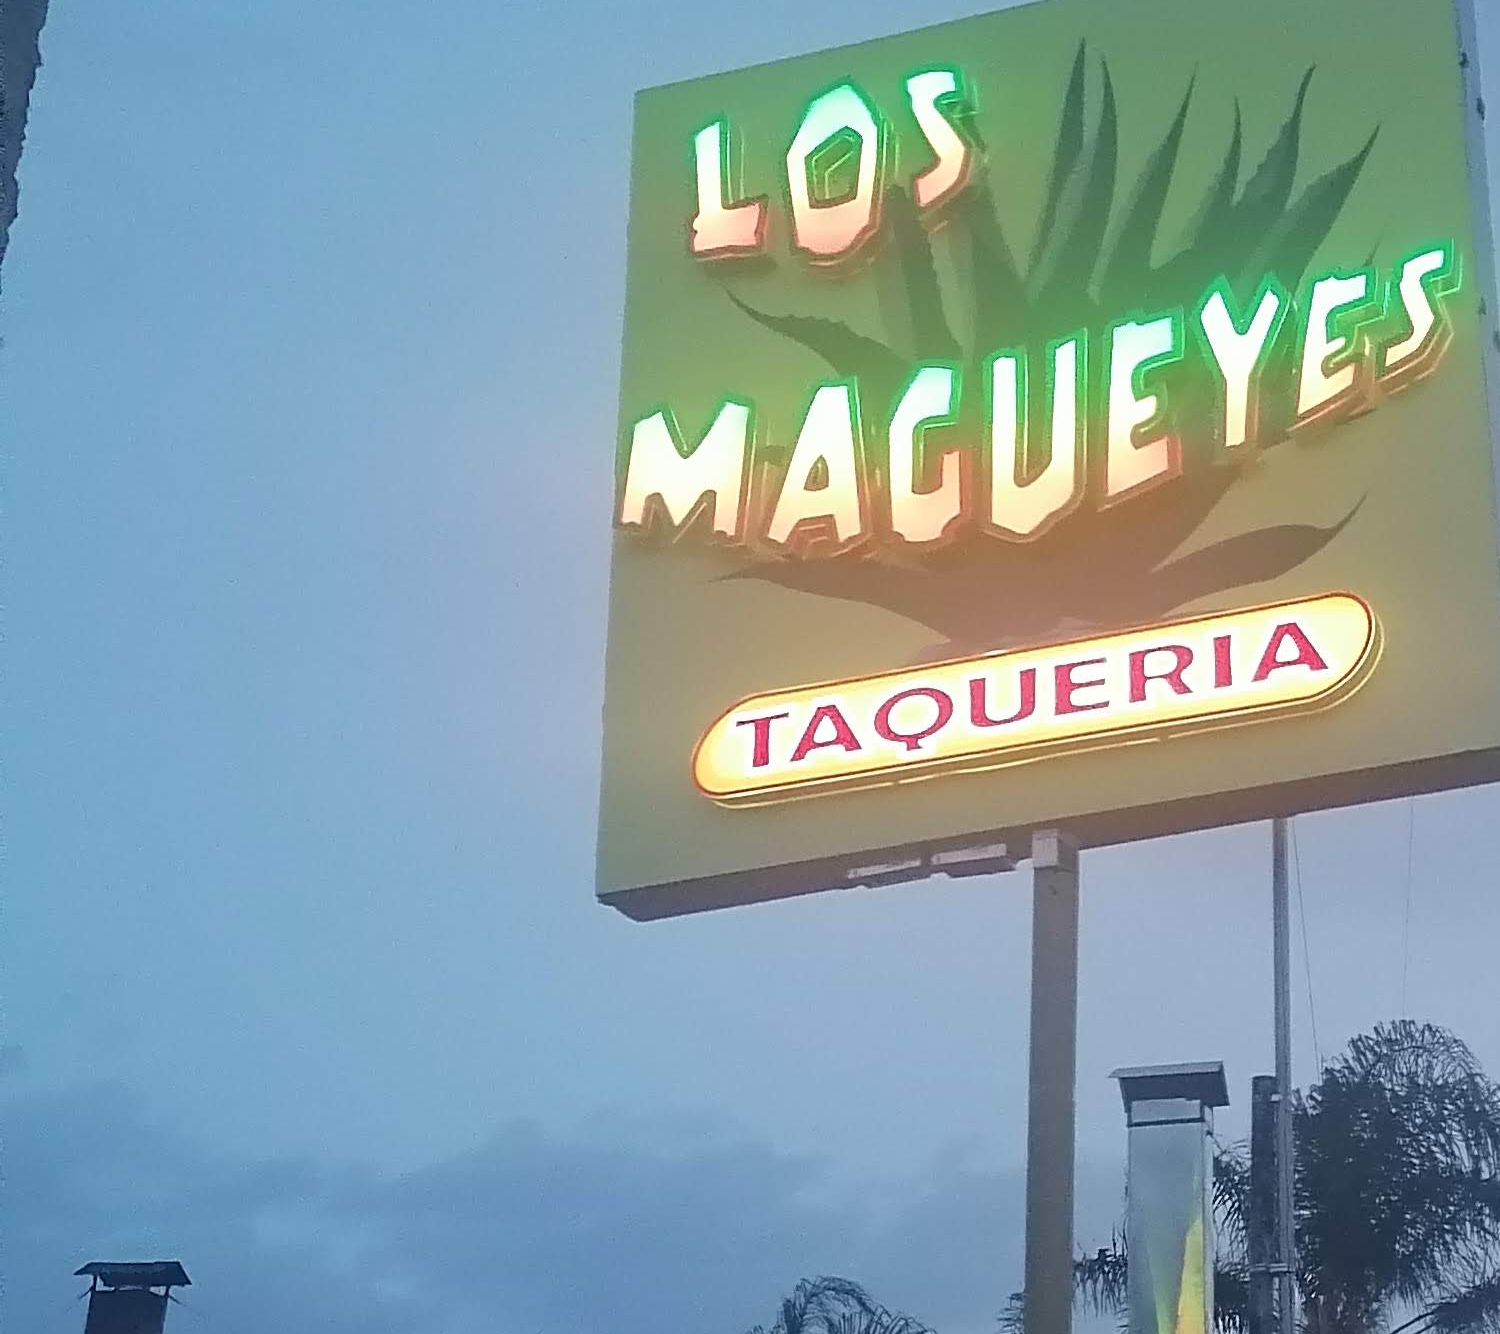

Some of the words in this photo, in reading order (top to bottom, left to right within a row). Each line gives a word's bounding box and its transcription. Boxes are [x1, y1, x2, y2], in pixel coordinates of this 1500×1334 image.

[691, 69, 967, 257] LOS
[619, 247, 1447, 546] MAGUEYES
[736, 621, 1329, 770] TAQUERIA
